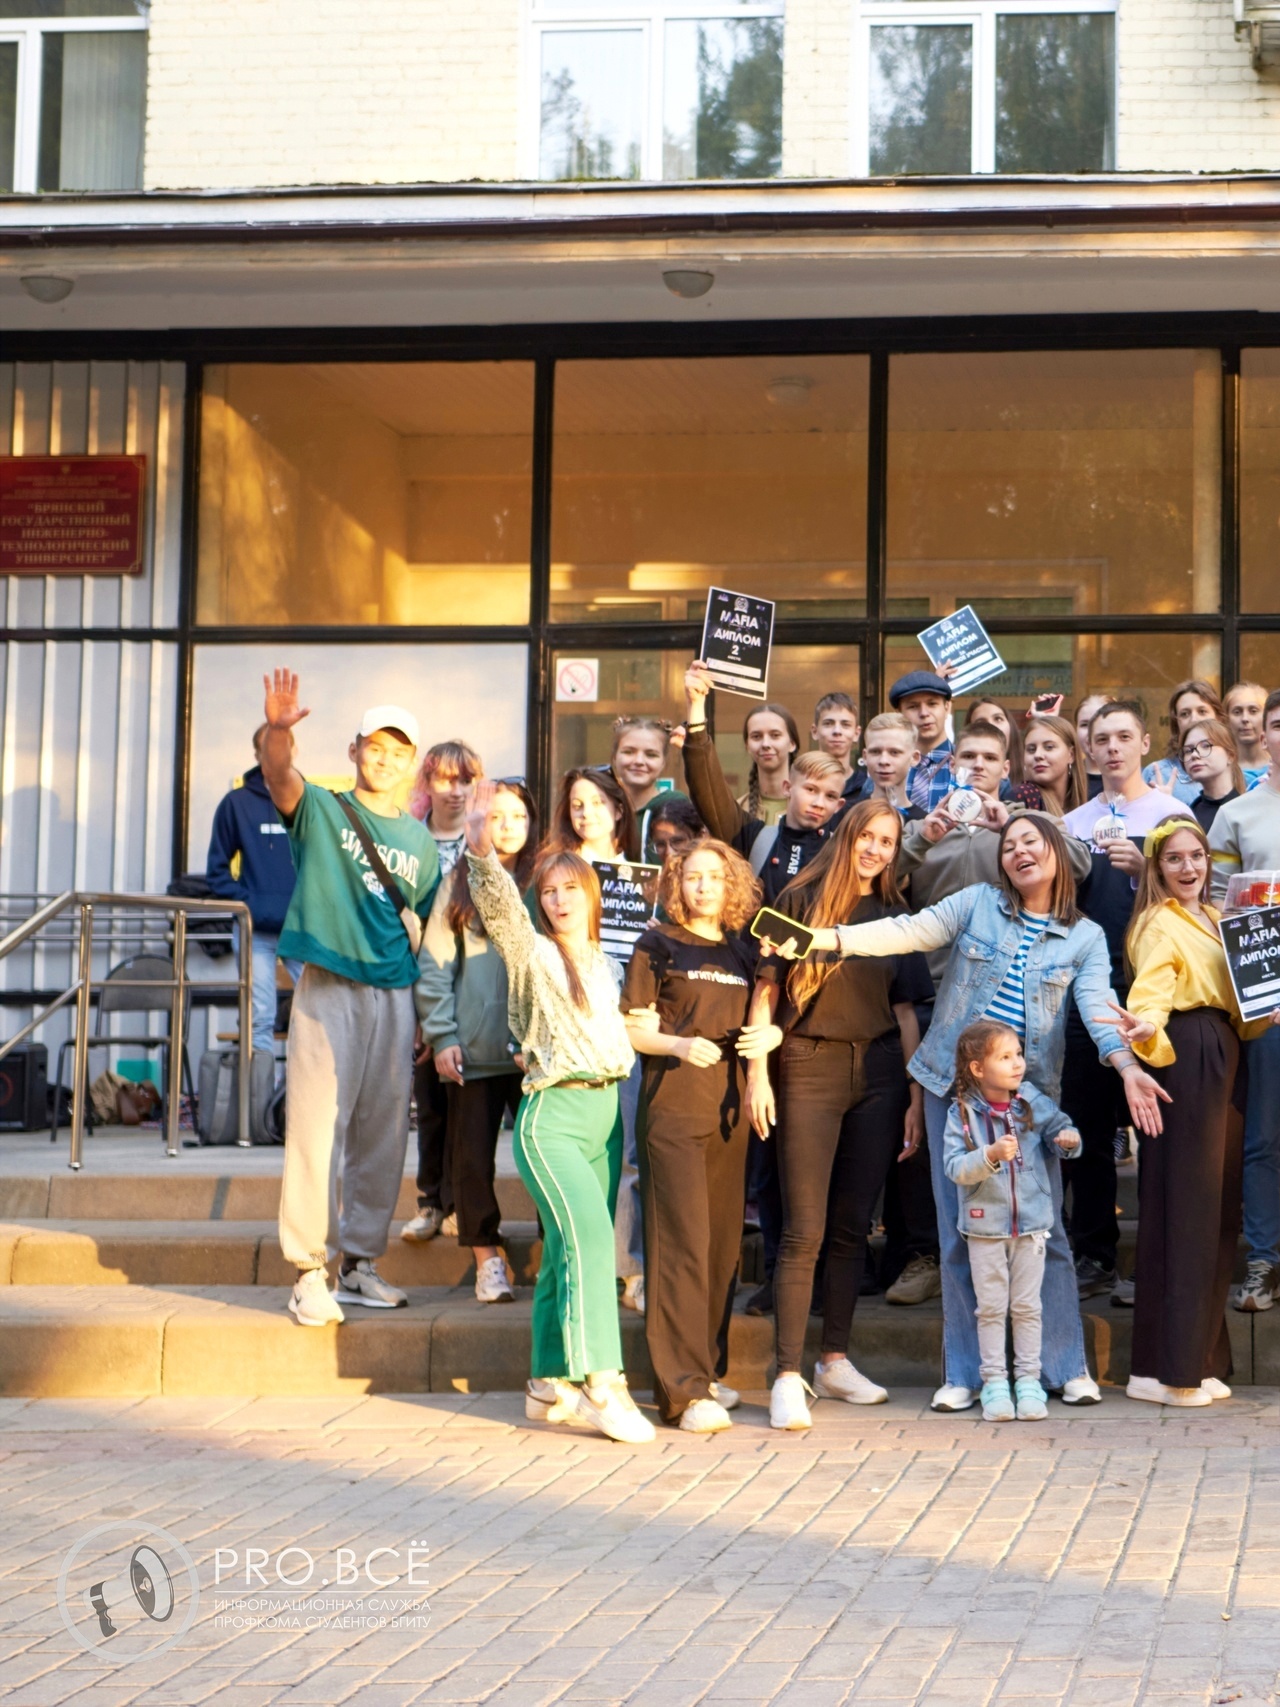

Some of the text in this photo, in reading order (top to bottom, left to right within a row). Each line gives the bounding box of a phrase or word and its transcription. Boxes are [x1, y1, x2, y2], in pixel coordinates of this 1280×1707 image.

[2, 514, 130, 526] ГОСУДАРСТВЕННЫЙ
[720, 610, 759, 629] MAFIA
[713, 628, 761, 647] ДИПЛОМ
[731, 644, 740, 655] 2
[786, 845, 801, 875] STAR
[602, 879, 643, 896] MAFIA
[1239, 927, 1280, 947] MAFIA
[1263, 962, 1270, 972] 1
